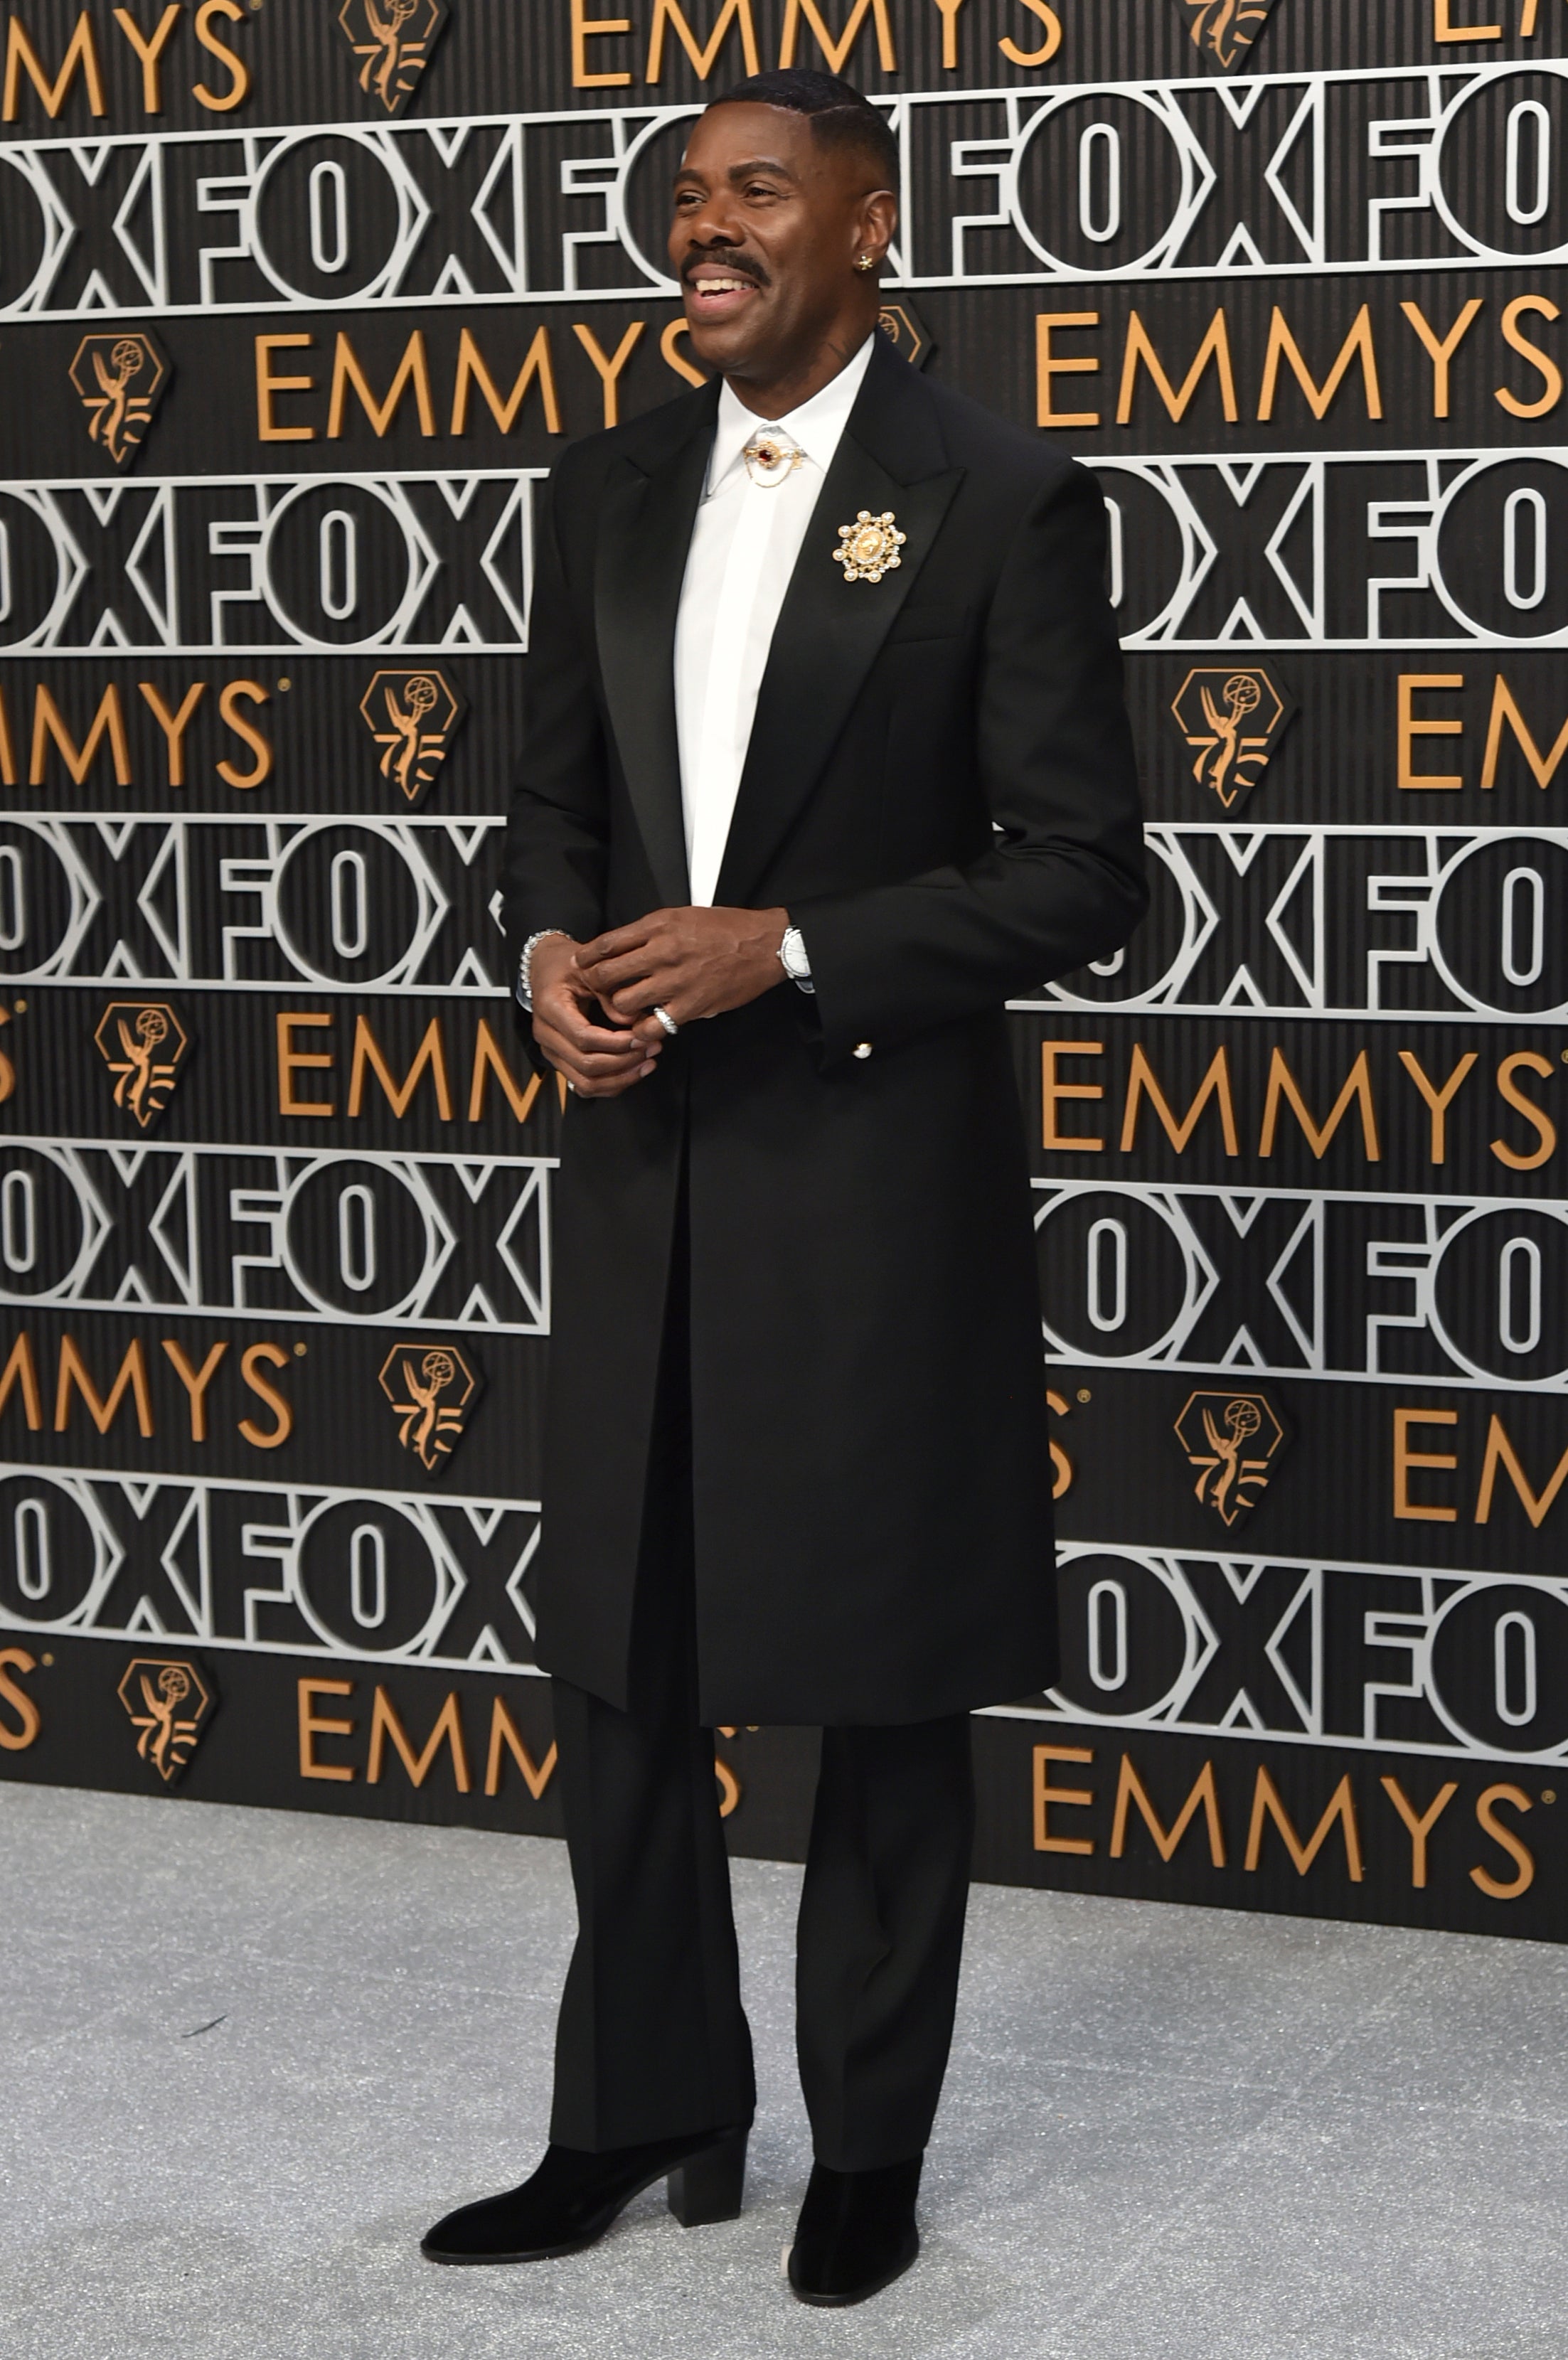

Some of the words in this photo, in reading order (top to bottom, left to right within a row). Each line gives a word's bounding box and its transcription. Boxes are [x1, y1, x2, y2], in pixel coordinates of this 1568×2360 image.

[2, 0, 247, 122] MYS
[152, 114, 526, 316] FOX
[900, 71, 1326, 288] FOX
[1313, 58, 1568, 274] FO
[1035, 294, 1563, 427] EMMYS
[165, 469, 533, 655] FOX
[1313, 447, 1568, 649] FO
[0, 679, 272, 789] MYS
[1313, 825, 1568, 1025] FO
[277, 1013, 567, 1123] EMM
[1042, 1041, 1556, 1170] EMMYS
[188, 1143, 551, 1335] FOX
[1030, 1178, 1324, 1379] OX
[1313, 1190, 1568, 1394] FO
[0, 1333, 293, 1449] MYS
[0, 1463, 210, 1646] OX
[1044, 1540, 1322, 1744] OX
[1311, 1560, 1568, 1767] FO
[298, 1678, 558, 1799] EMM
[1033, 1746, 1535, 1899] EMMYS
